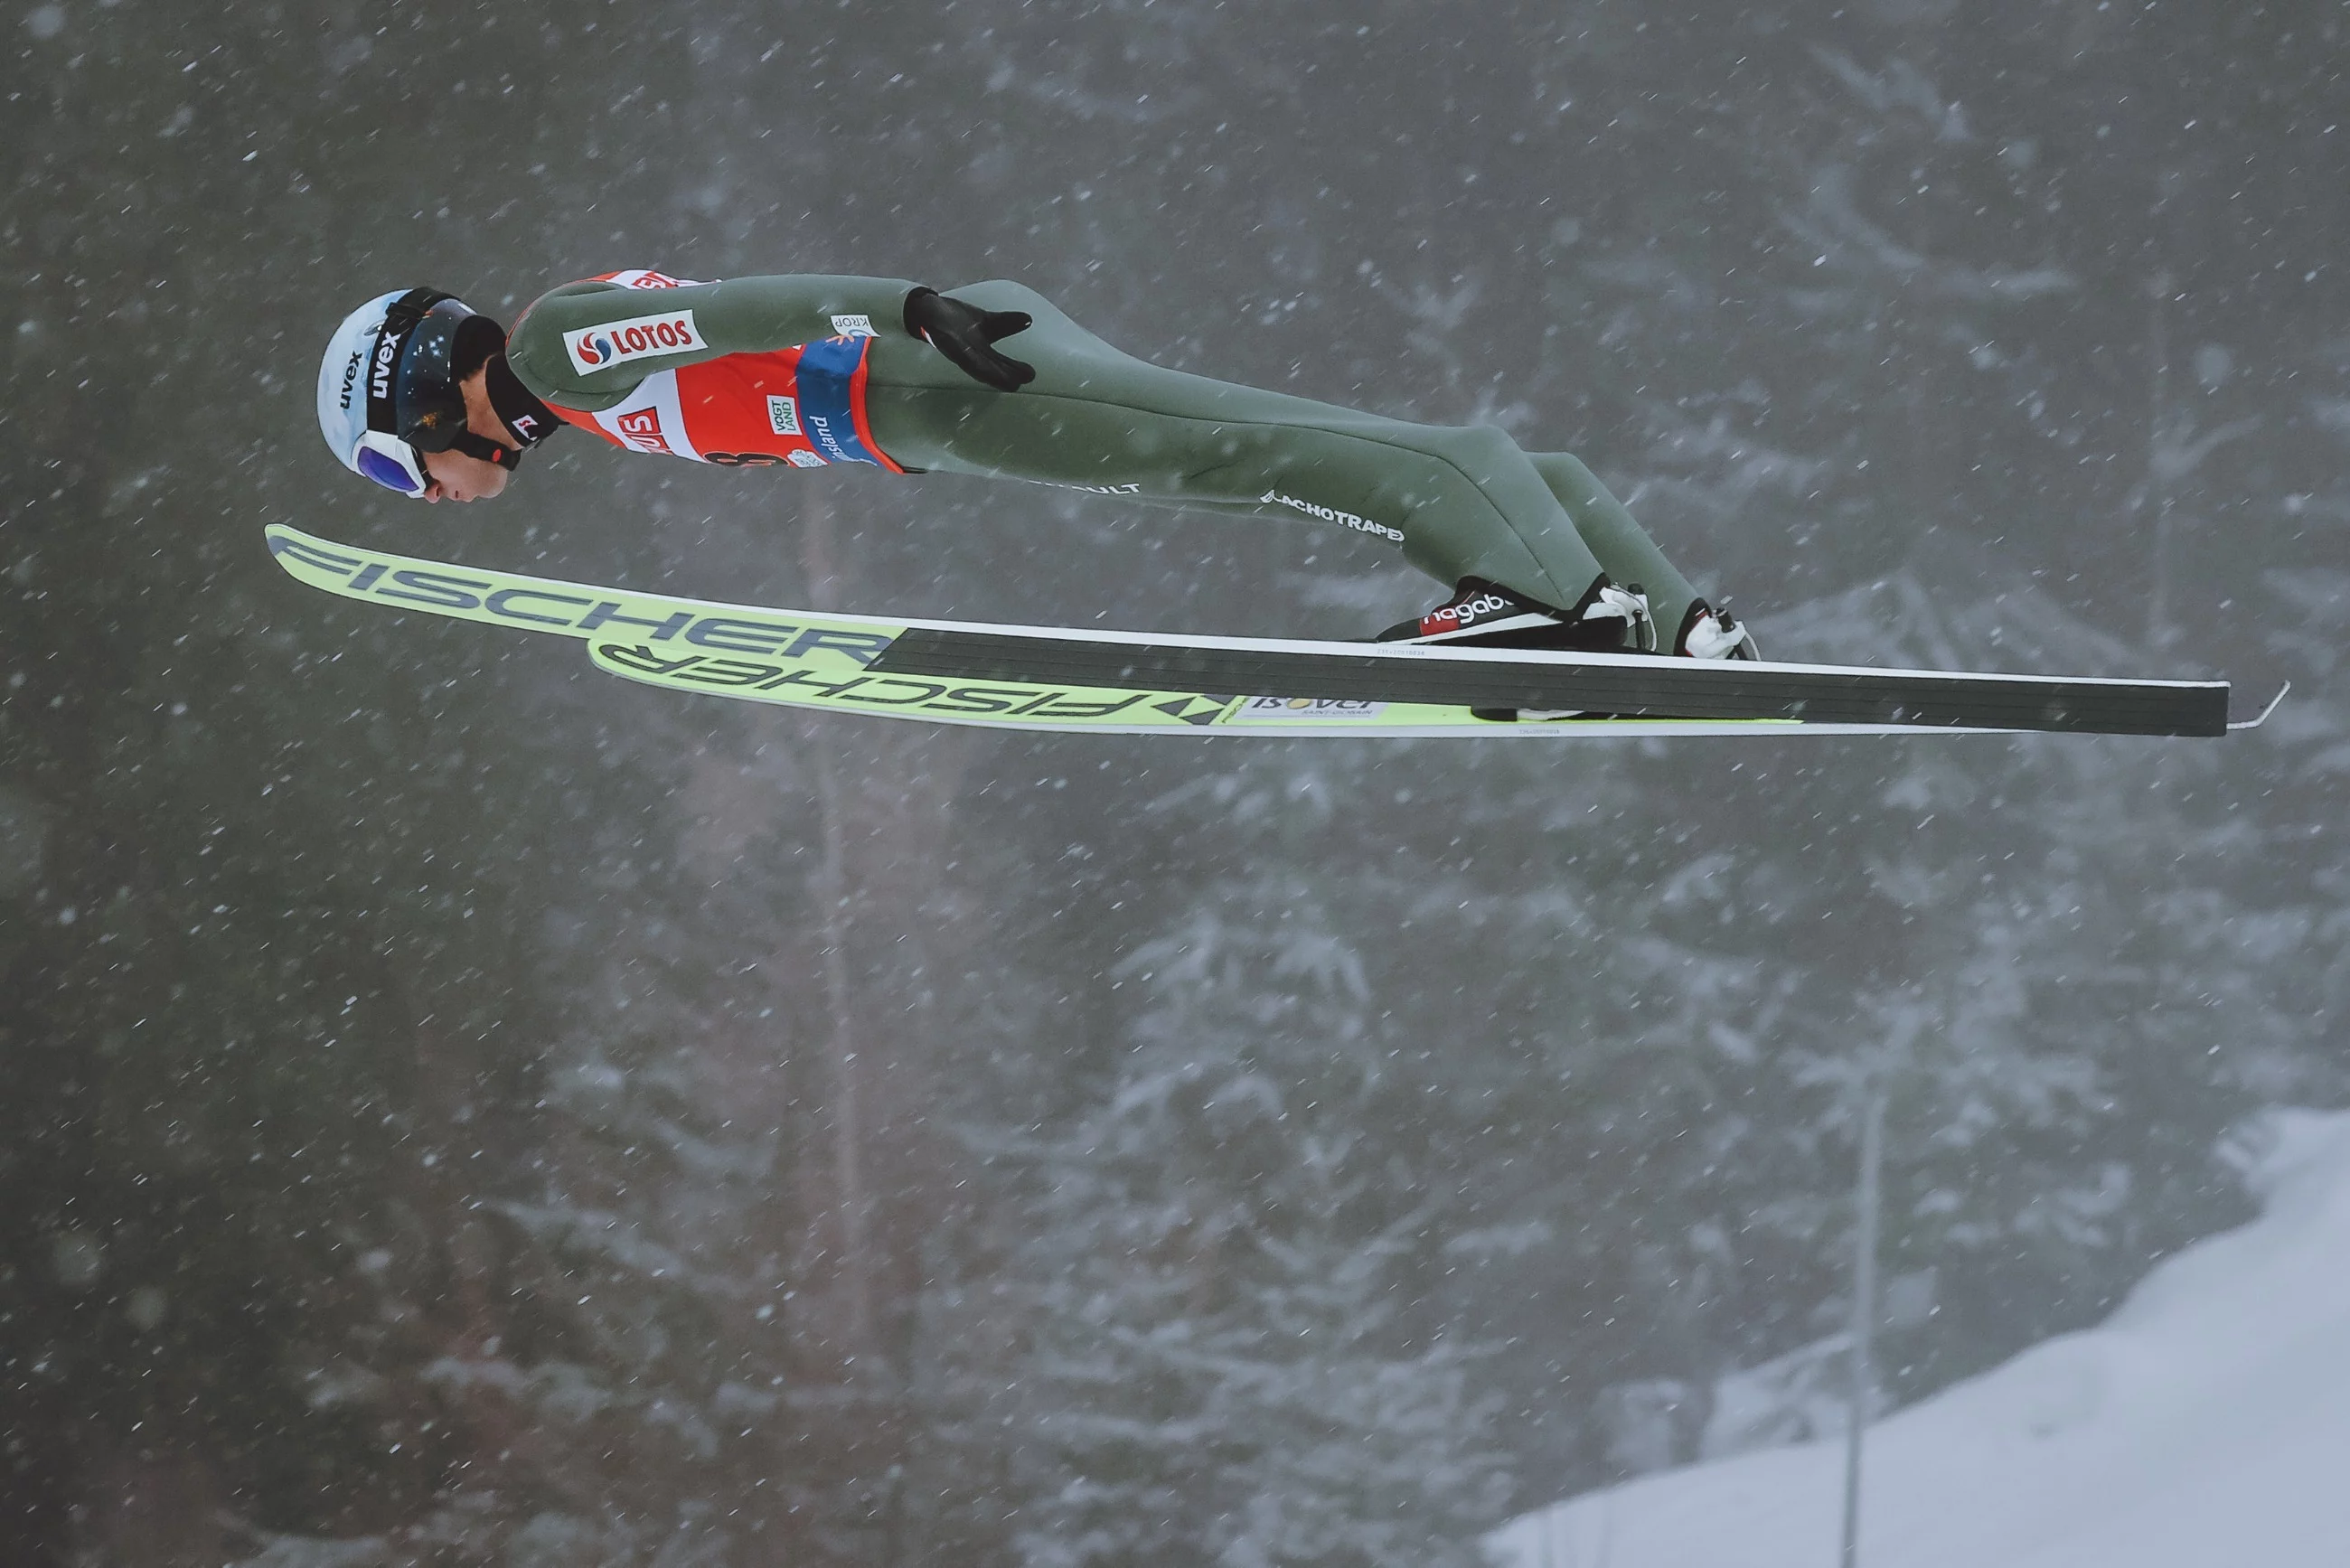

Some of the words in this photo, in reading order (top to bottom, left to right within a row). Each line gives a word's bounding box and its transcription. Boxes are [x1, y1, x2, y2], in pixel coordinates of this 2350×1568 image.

[610, 320, 692, 355] LOTOS
[340, 350, 363, 409] uvex
[372, 331, 401, 399] uvex
[771, 399, 786, 432] VOGT
[782, 401, 796, 431] LAND
[269, 535, 896, 665] FISCHER
[1424, 593, 1515, 624] nagab
[599, 644, 1152, 718] FISCHER
